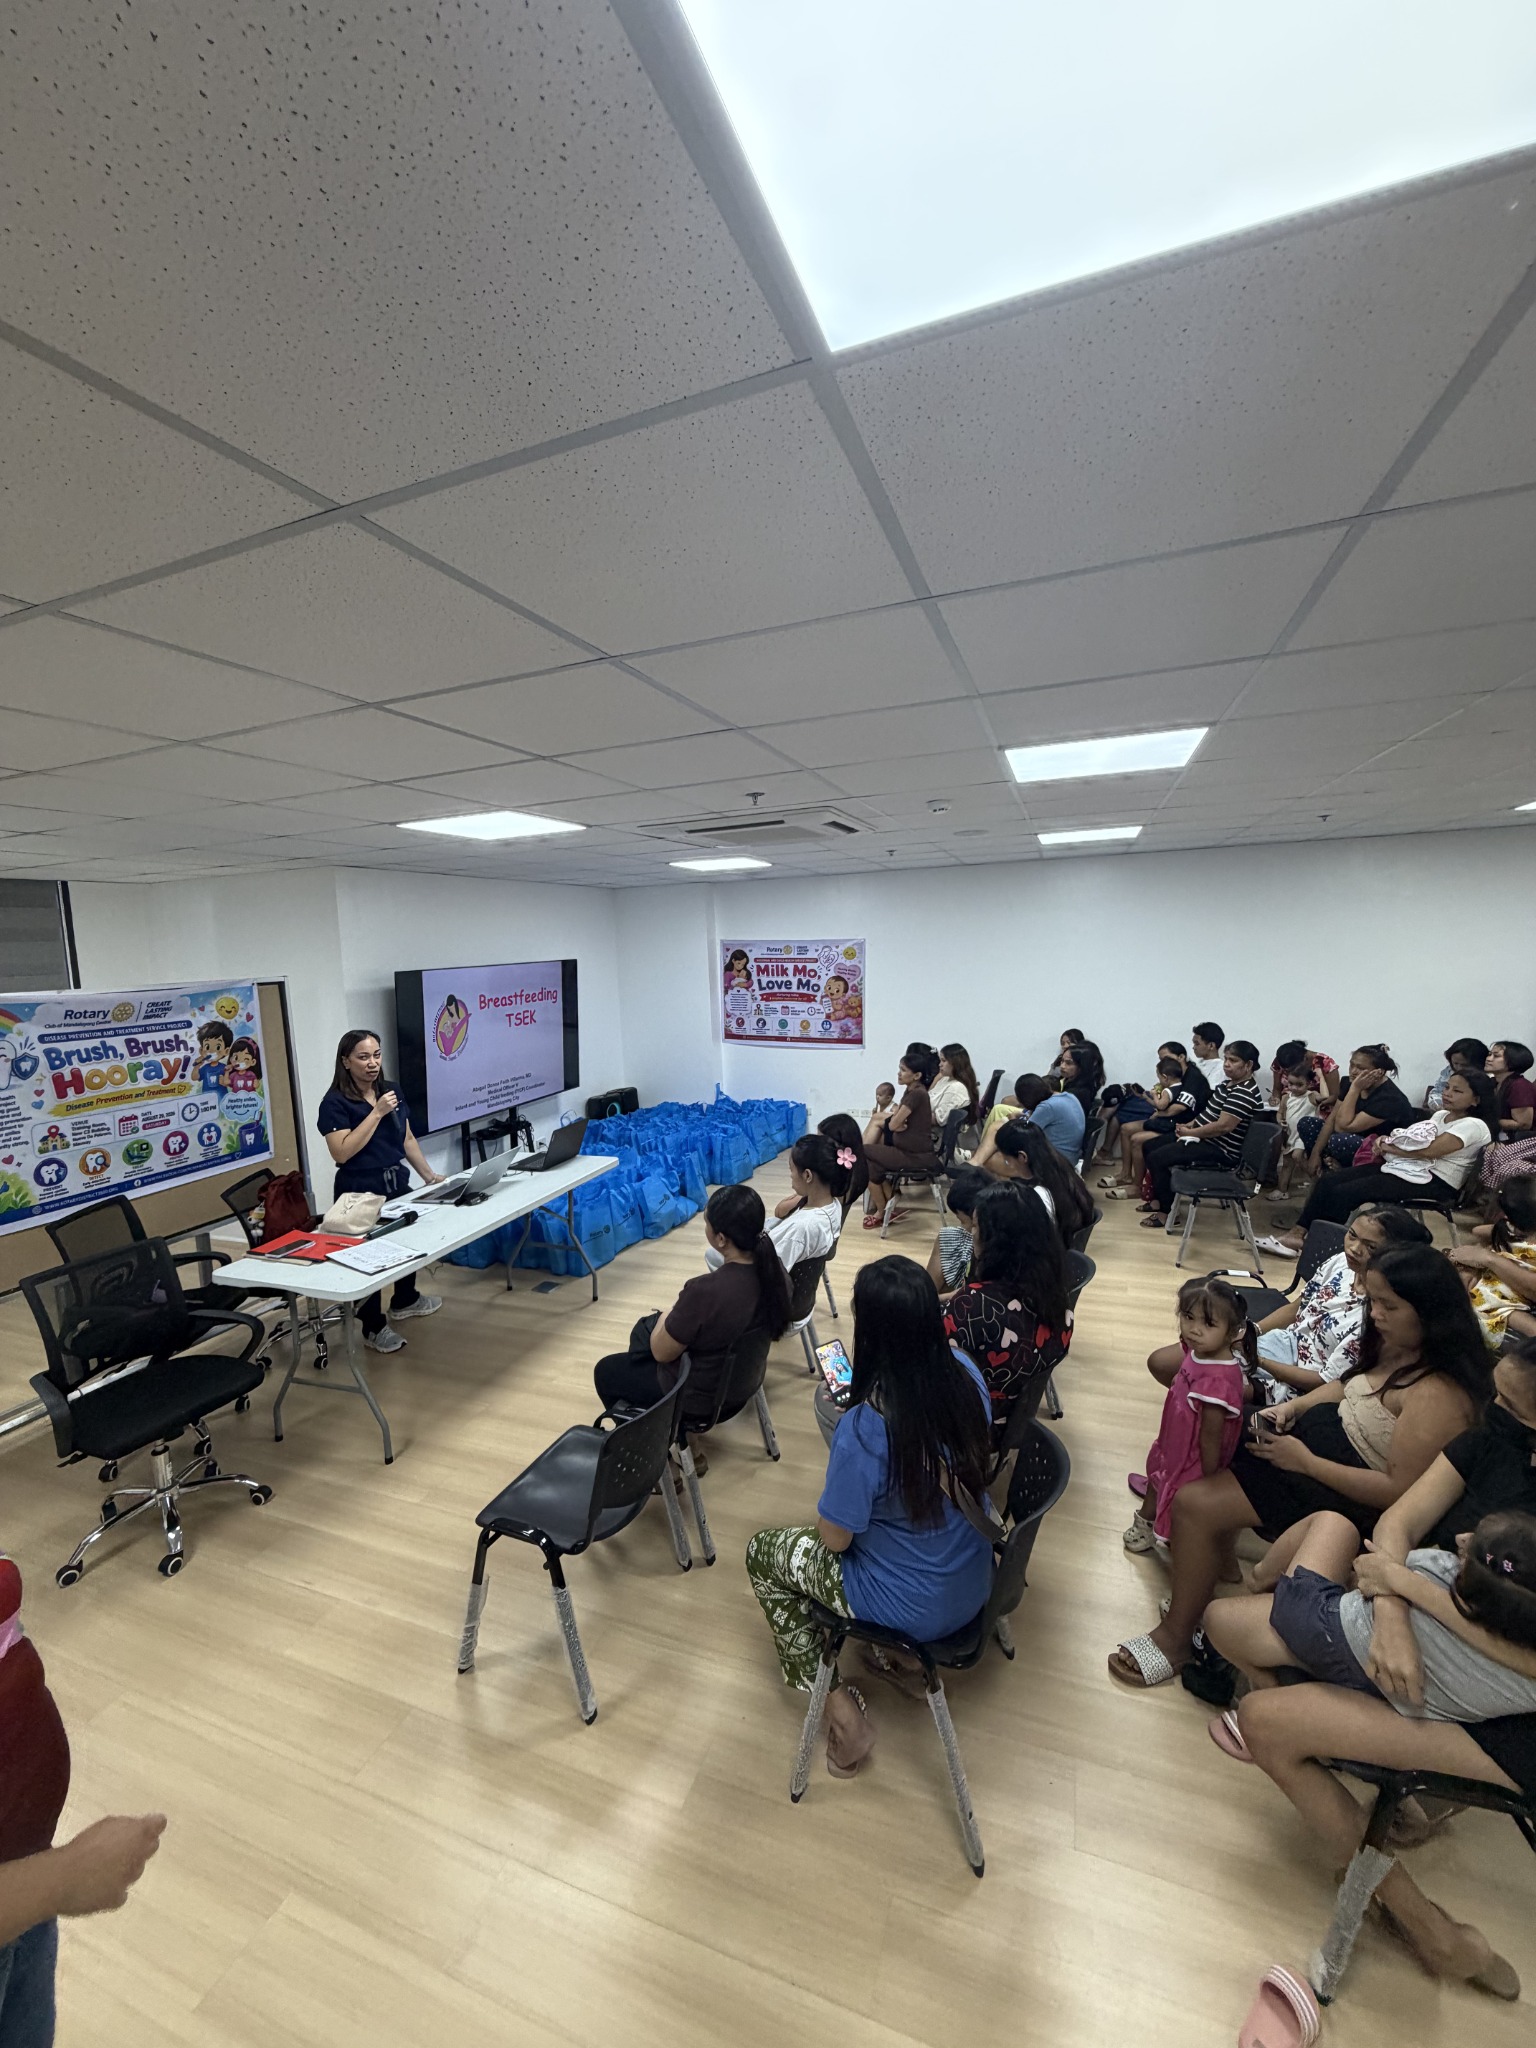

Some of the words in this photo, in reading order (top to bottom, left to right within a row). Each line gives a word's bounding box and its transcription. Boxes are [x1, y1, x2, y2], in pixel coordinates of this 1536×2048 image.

[756, 964, 788, 977] Milk
[792, 964, 821, 980] Mo,
[757, 978, 792, 991] Love
[796, 978, 820, 992] Mo
[479, 987, 558, 1010] Breastfeeding
[64, 1009, 111, 1020] Rotary
[506, 1009, 537, 1028] TSEK
[116, 1027, 145, 1035] TREATMENT
[43, 1040, 124, 1071] Brush,
[124, 1034, 195, 1058] Brush,
[52, 1055, 191, 1099] Hooray!
[66, 1101, 94, 1112] Disease
[96, 1094, 133, 1105] Prevention
[146, 1088, 176, 1096] Treatment
